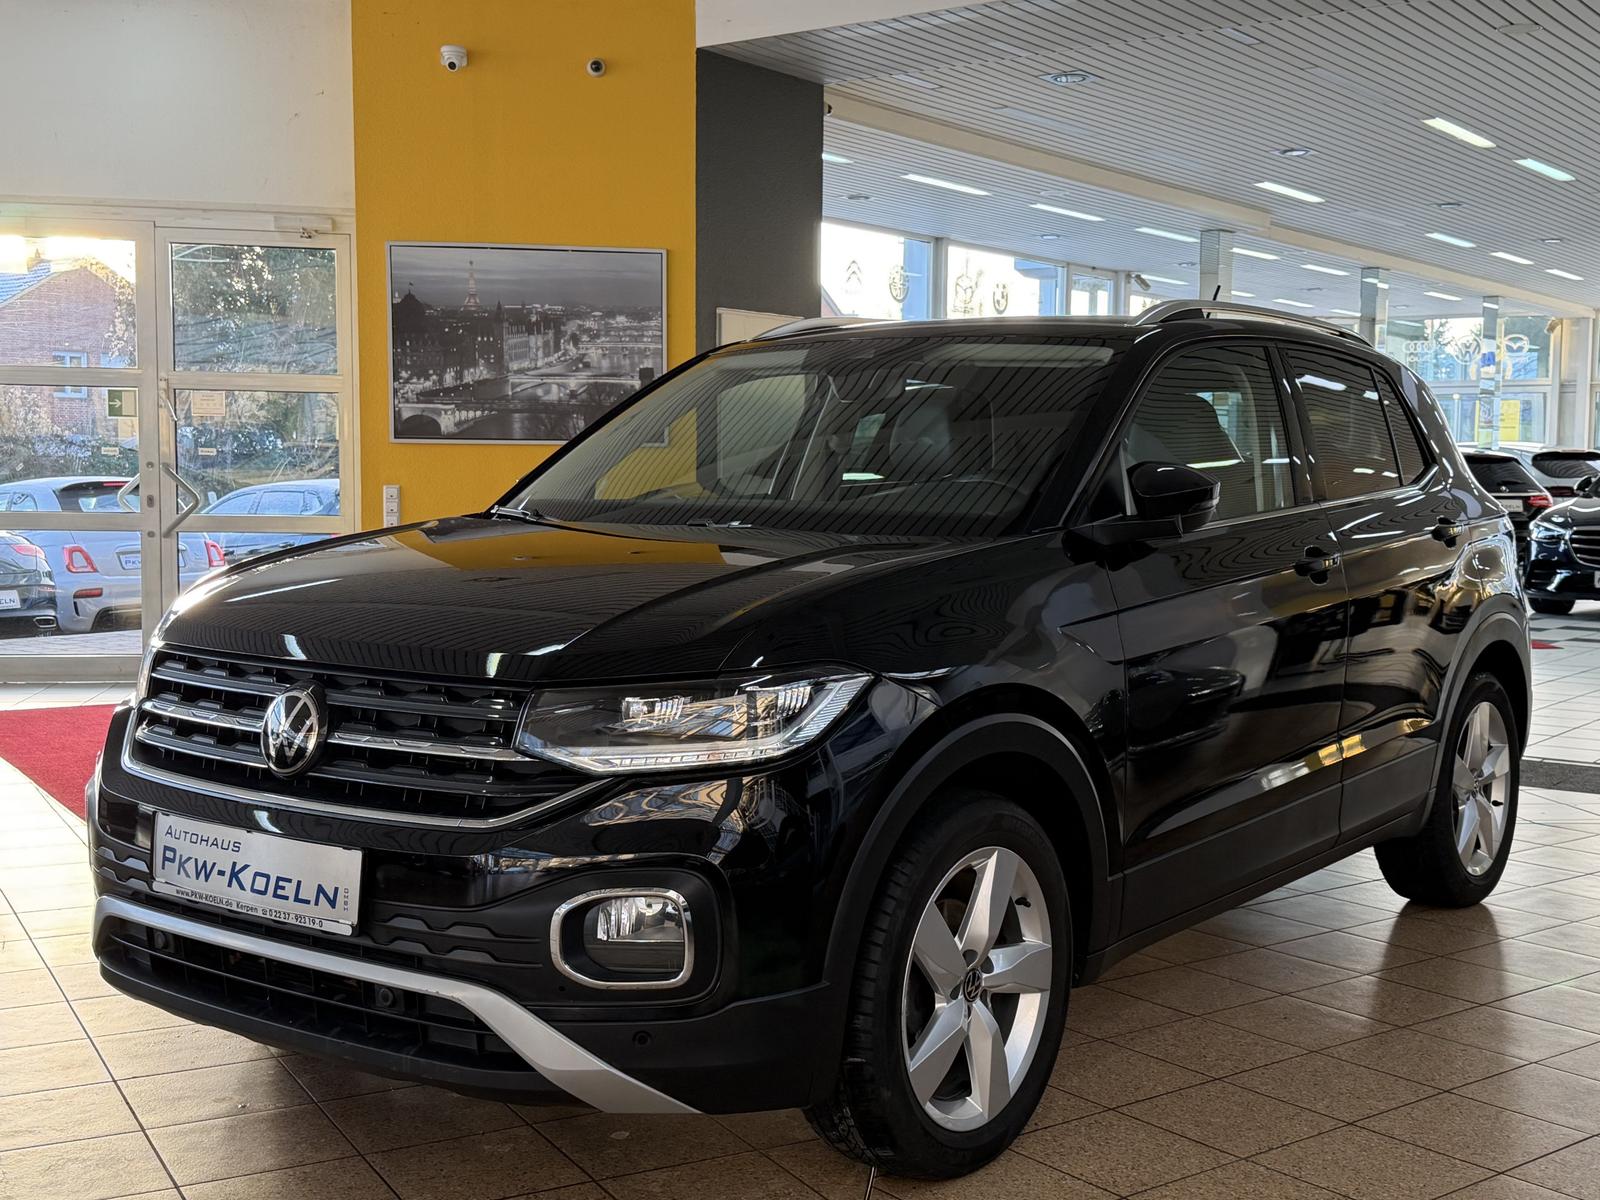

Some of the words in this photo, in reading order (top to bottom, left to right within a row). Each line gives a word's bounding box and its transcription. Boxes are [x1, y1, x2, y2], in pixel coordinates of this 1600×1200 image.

[164, 824, 242, 853] AUTOHAUS
[161, 845, 339, 909] PKW-KOELN
[236, 902, 259, 914] Kerpen
